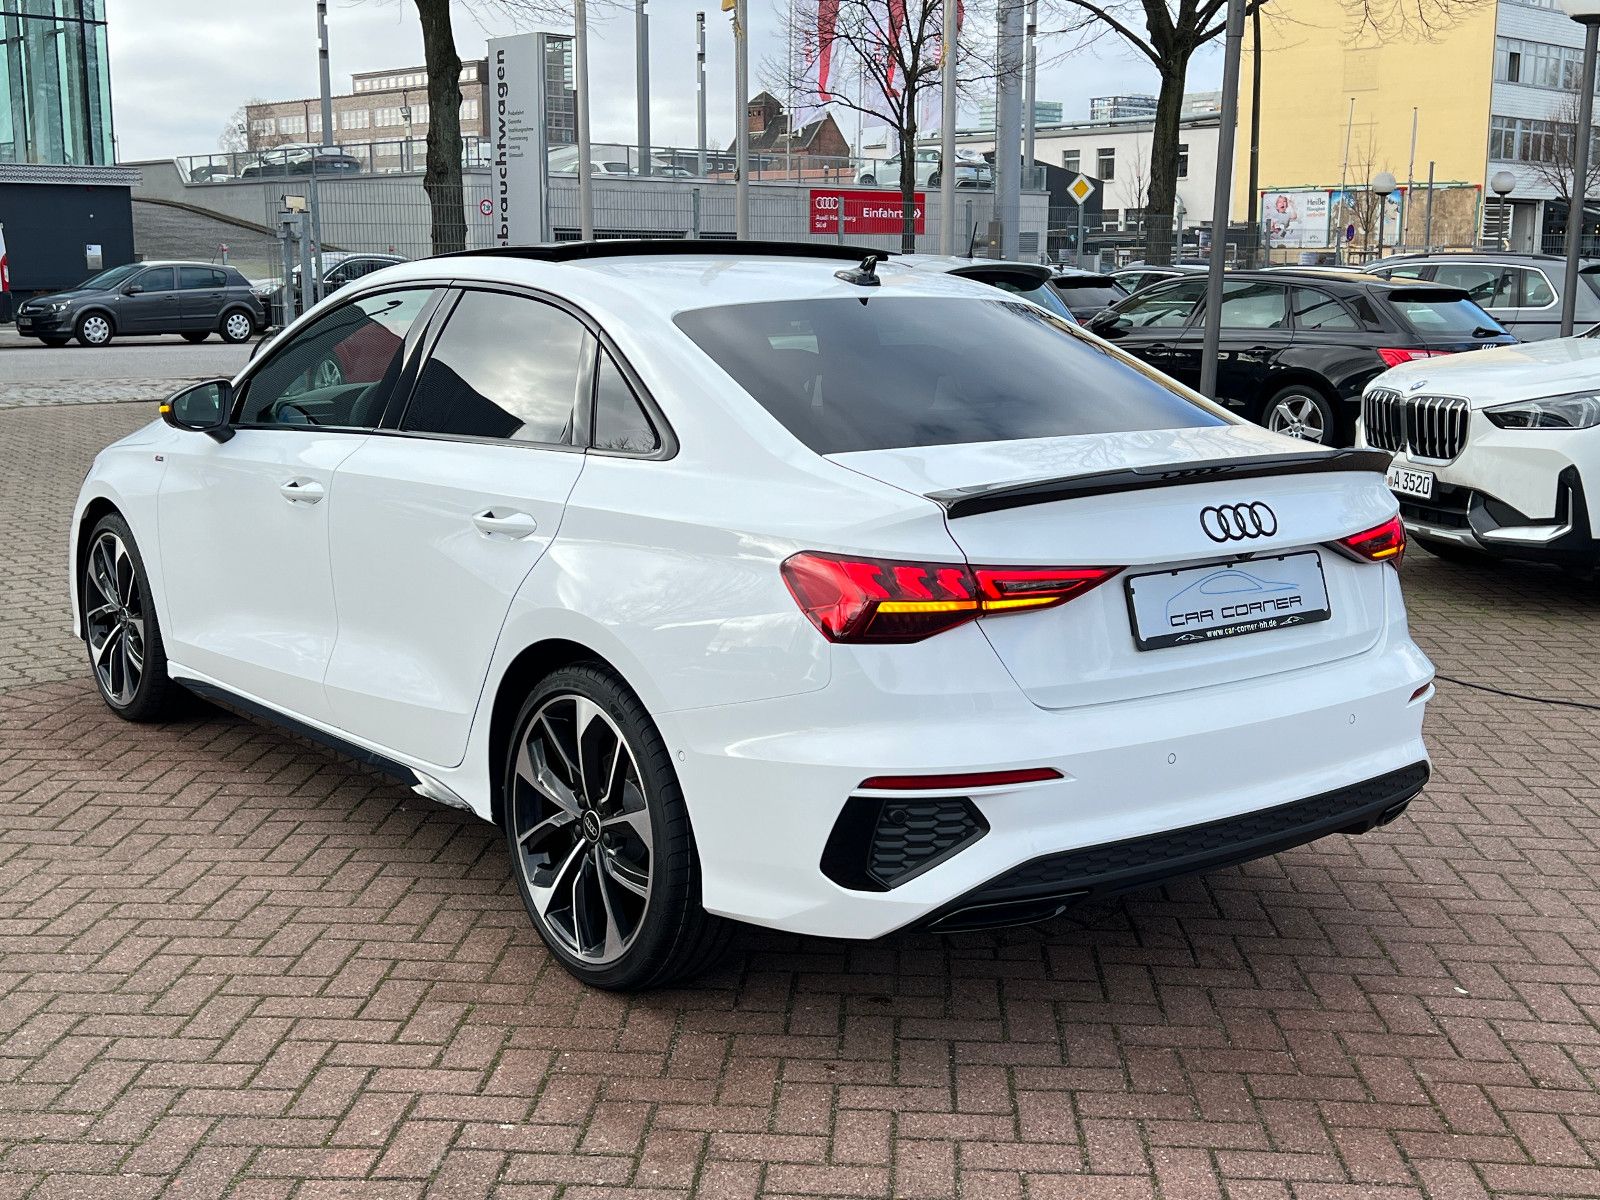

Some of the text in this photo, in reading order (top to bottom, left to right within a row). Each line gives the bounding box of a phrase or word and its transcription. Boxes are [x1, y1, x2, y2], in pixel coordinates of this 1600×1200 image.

[863, 208, 903, 218] Einfahrt
[1393, 471, 1430, 494] A 3520
[1170, 596, 1303, 627] CAR CORNER
[1206, 619, 1278, 638] www.car-corner-hh.de
